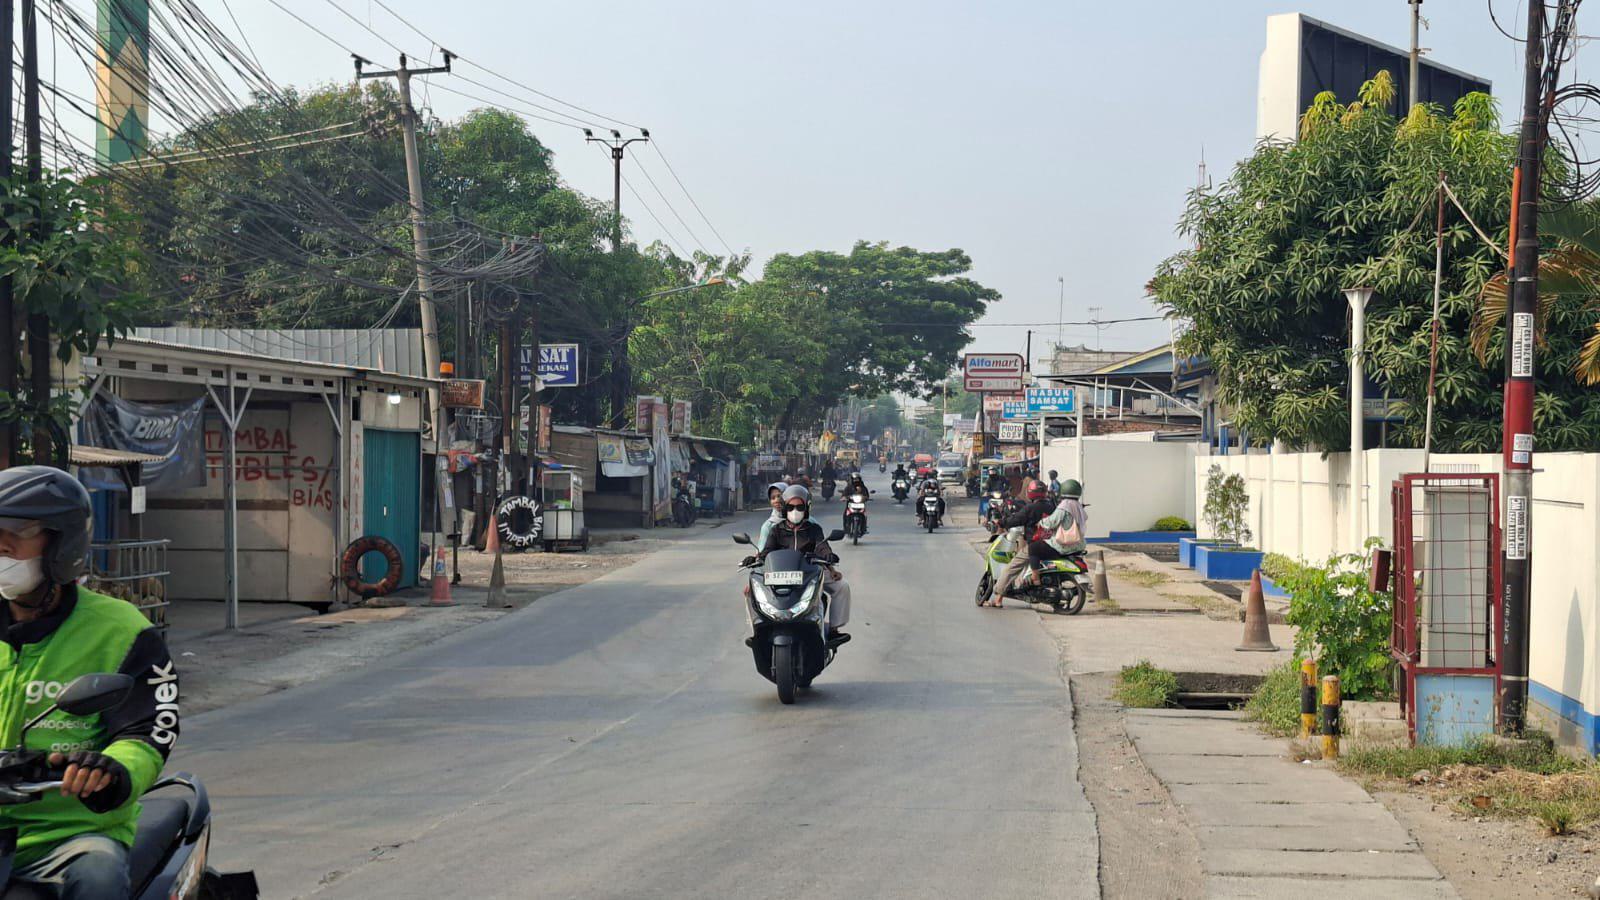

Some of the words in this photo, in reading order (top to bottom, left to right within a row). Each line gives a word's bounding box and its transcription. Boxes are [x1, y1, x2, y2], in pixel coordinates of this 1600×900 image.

[968, 357, 1018, 368] Alfamart
[1030, 397, 1069, 405] SAMSAT
[500, 496, 540, 517] TAMBAL
[1511, 499, 1521, 510] WC
